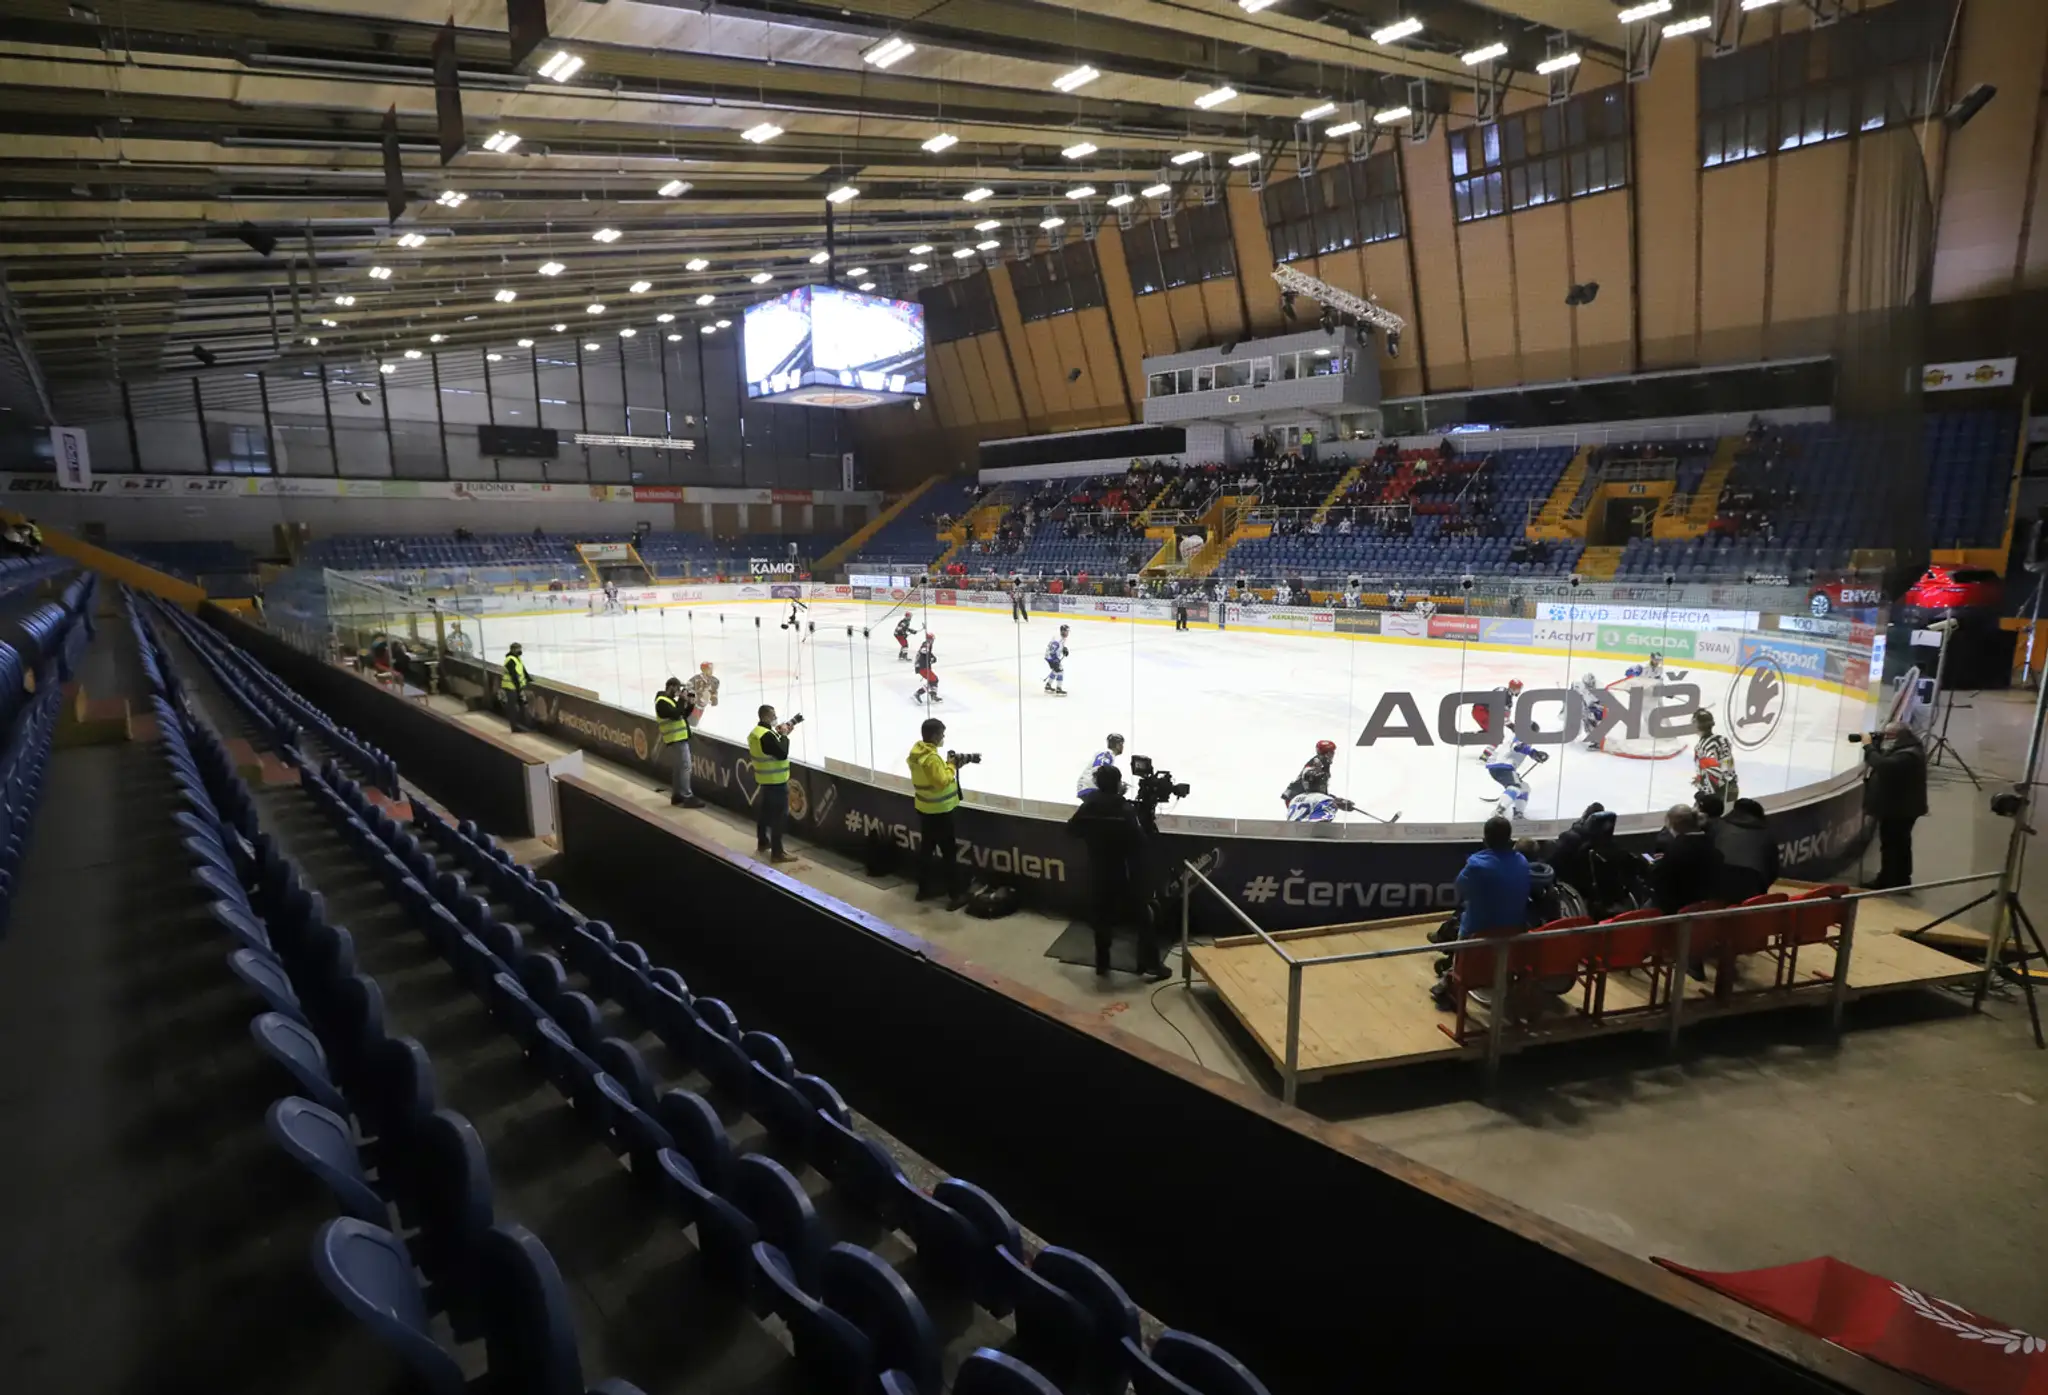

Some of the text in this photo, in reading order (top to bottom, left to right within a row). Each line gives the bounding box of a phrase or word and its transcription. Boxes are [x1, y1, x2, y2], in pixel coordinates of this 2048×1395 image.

[466, 482, 516, 492] EUROINEX
[750, 562, 795, 575] KAMIQ
[1104, 602, 1129, 613] TIPOS
[1622, 609, 1711, 624] DEZINFEKCIA
[1792, 618, 1813, 632] 100
[1548, 630, 1596, 643] ActivIT
[1626, 633, 1690, 650] ŠKODA
[1699, 641, 1731, 654] SWAN
[1760, 643, 1820, 671] Tipsport
